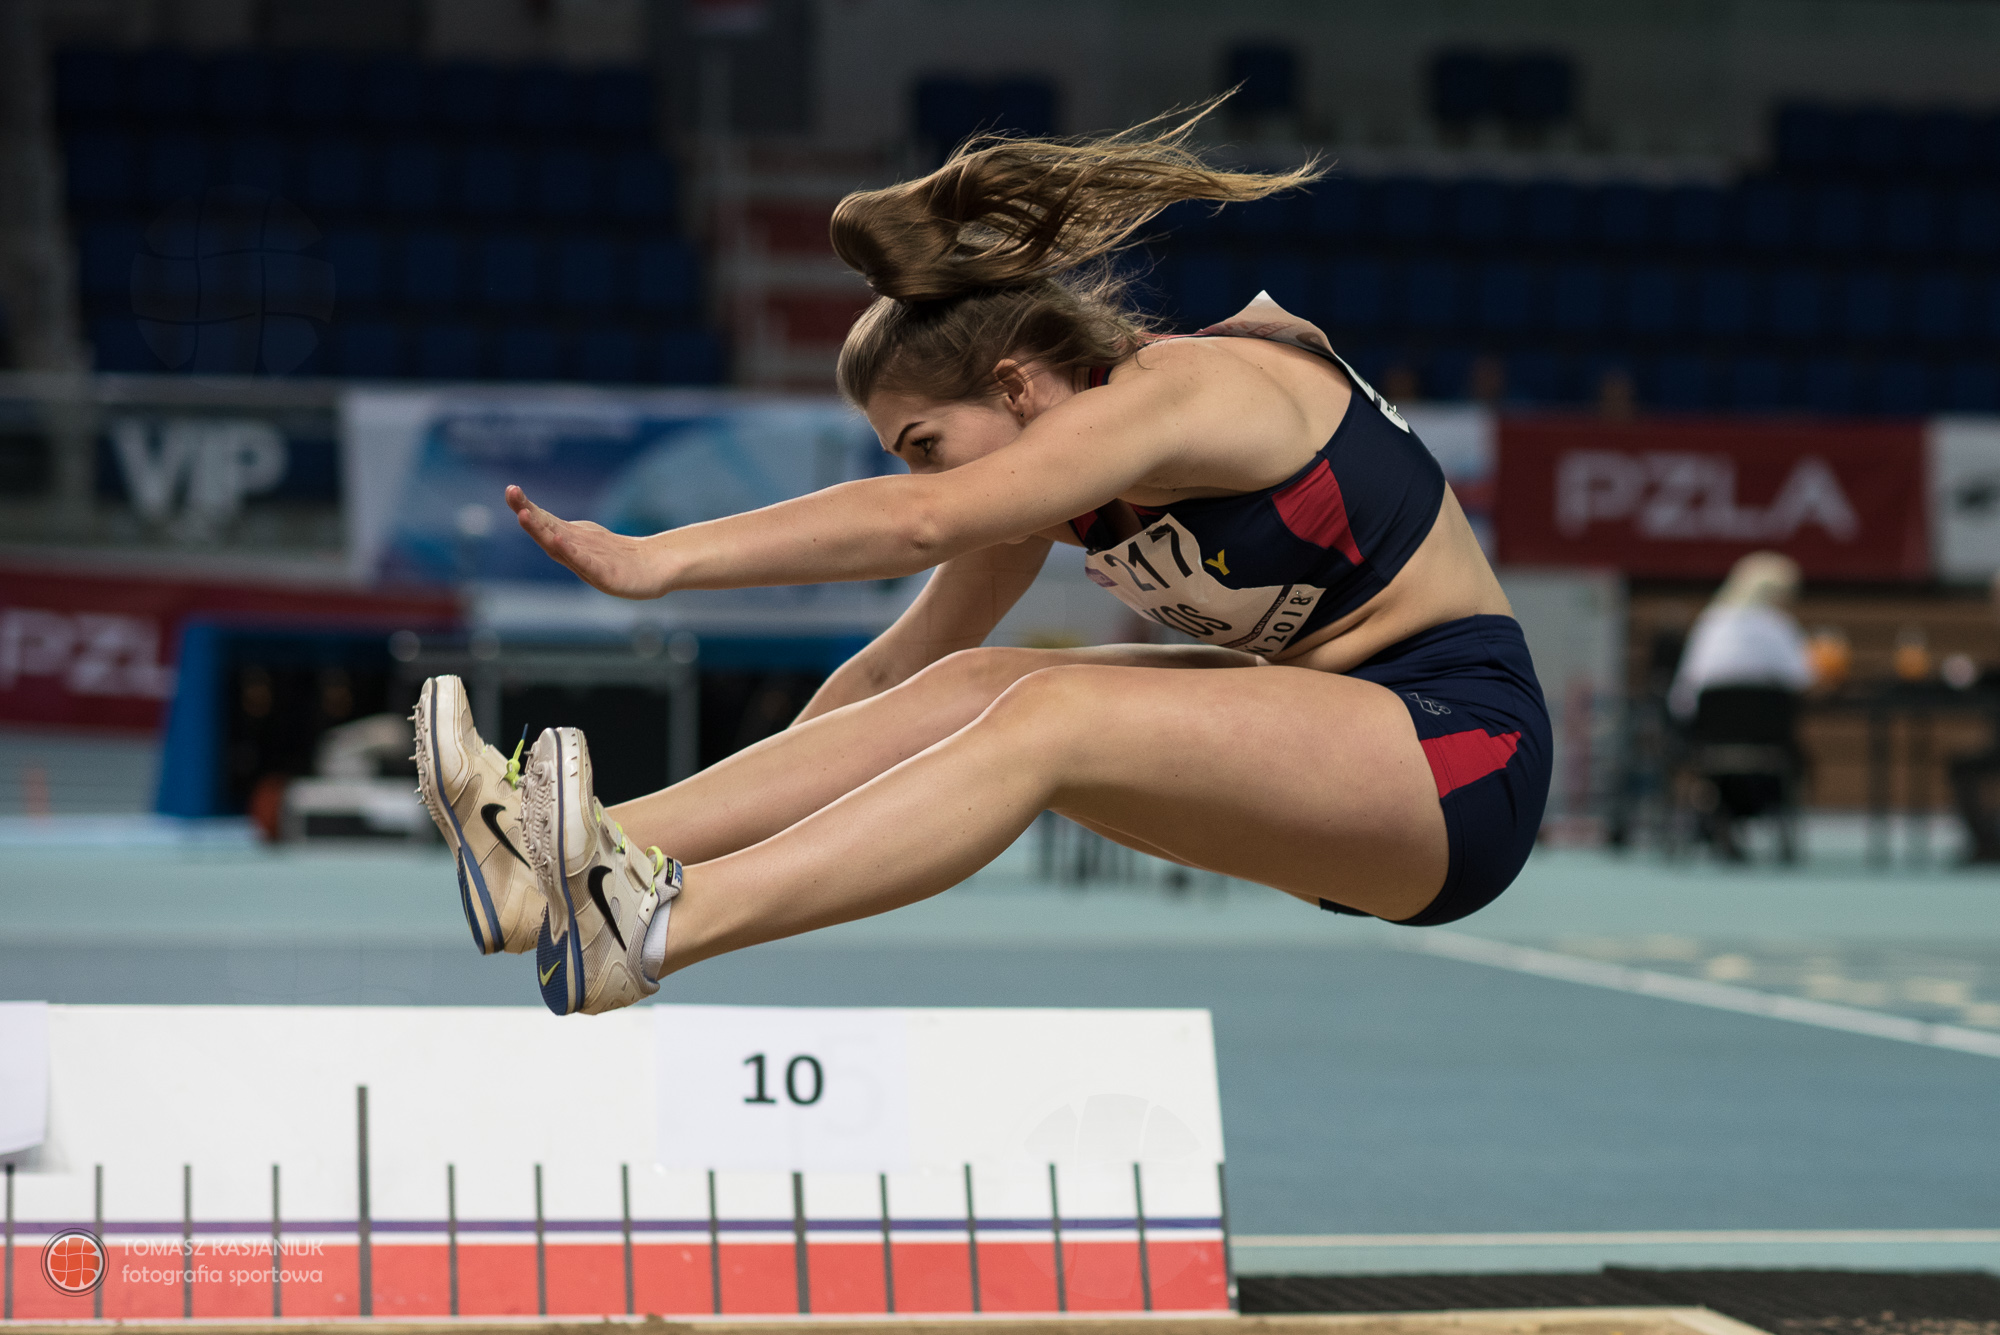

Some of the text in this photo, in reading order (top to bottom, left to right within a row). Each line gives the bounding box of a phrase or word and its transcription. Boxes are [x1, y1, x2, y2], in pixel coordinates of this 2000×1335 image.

[109, 414, 291, 528] VIP
[1554, 448, 1858, 542] PZLA
[1104, 523, 1193, 592] 217
[1264, 596, 1314, 643] 2018
[742, 1053, 825, 1105] 10
